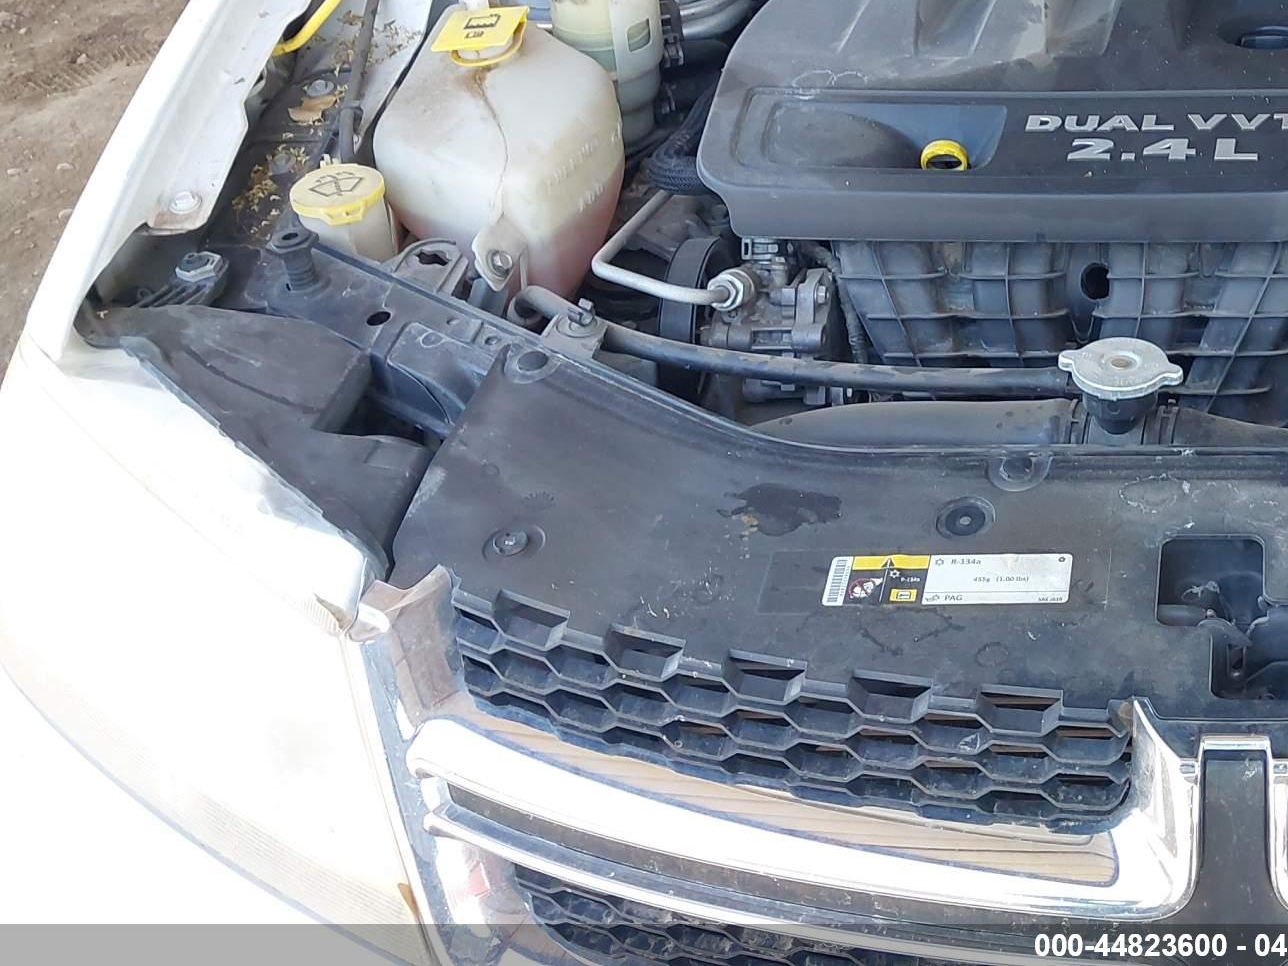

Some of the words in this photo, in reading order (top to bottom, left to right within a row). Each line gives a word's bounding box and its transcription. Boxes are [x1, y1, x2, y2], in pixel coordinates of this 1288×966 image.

[1025, 113, 1175, 132] DUAL
[1067, 138, 1196, 162] 2.4
[1214, 138, 1259, 162] L
